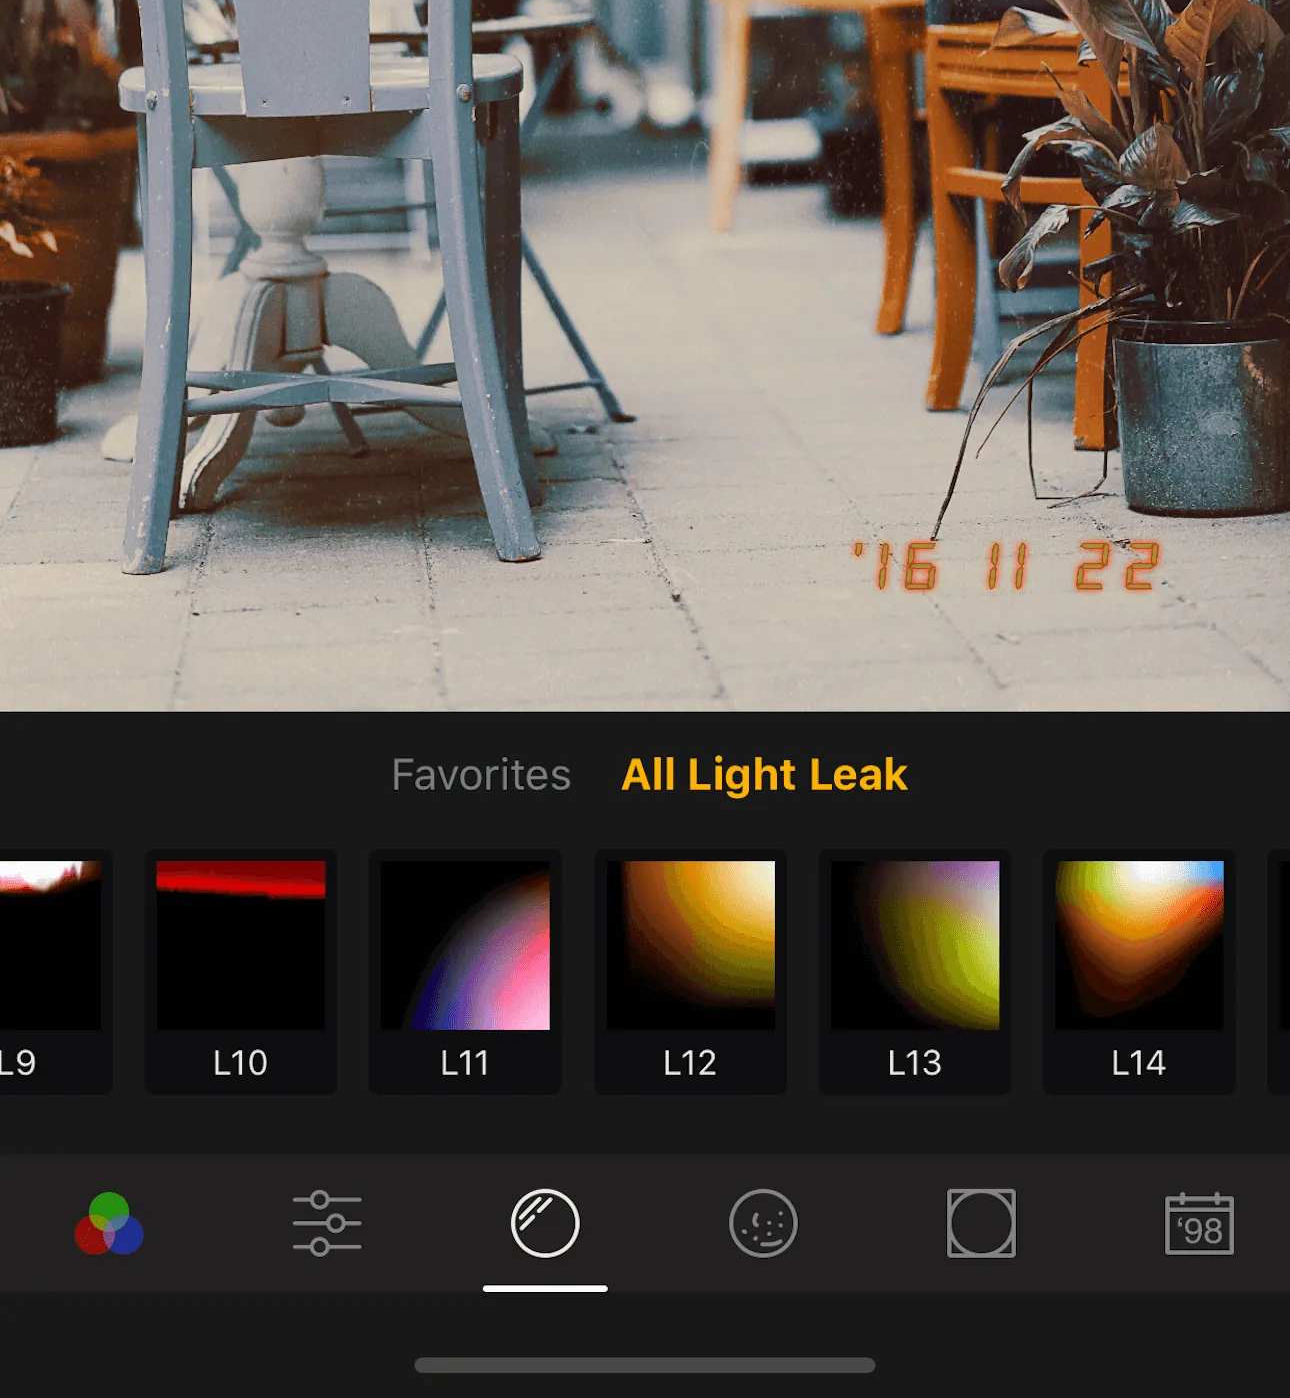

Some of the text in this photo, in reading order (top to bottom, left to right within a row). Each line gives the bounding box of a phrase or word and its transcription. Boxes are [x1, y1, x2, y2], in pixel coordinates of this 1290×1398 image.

[392, 756, 571, 791] Favorites
[621, 754, 909, 800] All Light Leak
[213, 1048, 268, 1076] L10
[441, 1049, 488, 1076] L11
[664, 1048, 717, 1076] L12
[889, 1048, 942, 1077] L13
[1112, 1049, 1167, 1076] L14
